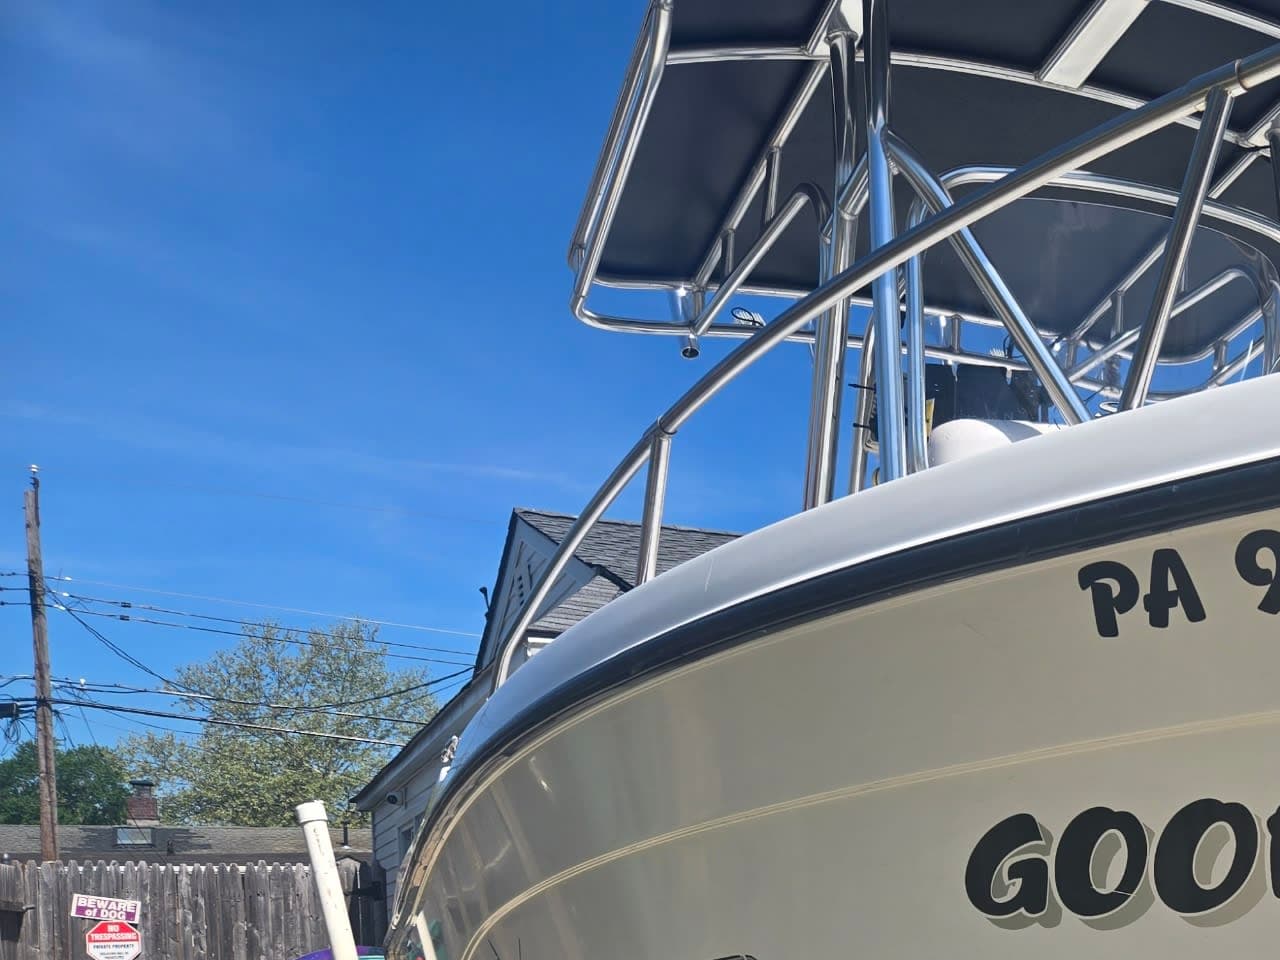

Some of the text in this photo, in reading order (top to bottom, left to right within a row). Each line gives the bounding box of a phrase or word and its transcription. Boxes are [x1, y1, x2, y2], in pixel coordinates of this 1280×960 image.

[1078, 548, 1206, 638] PA
[77, 896, 137, 913] BEWARE
[84, 908, 126, 920] of DOG
